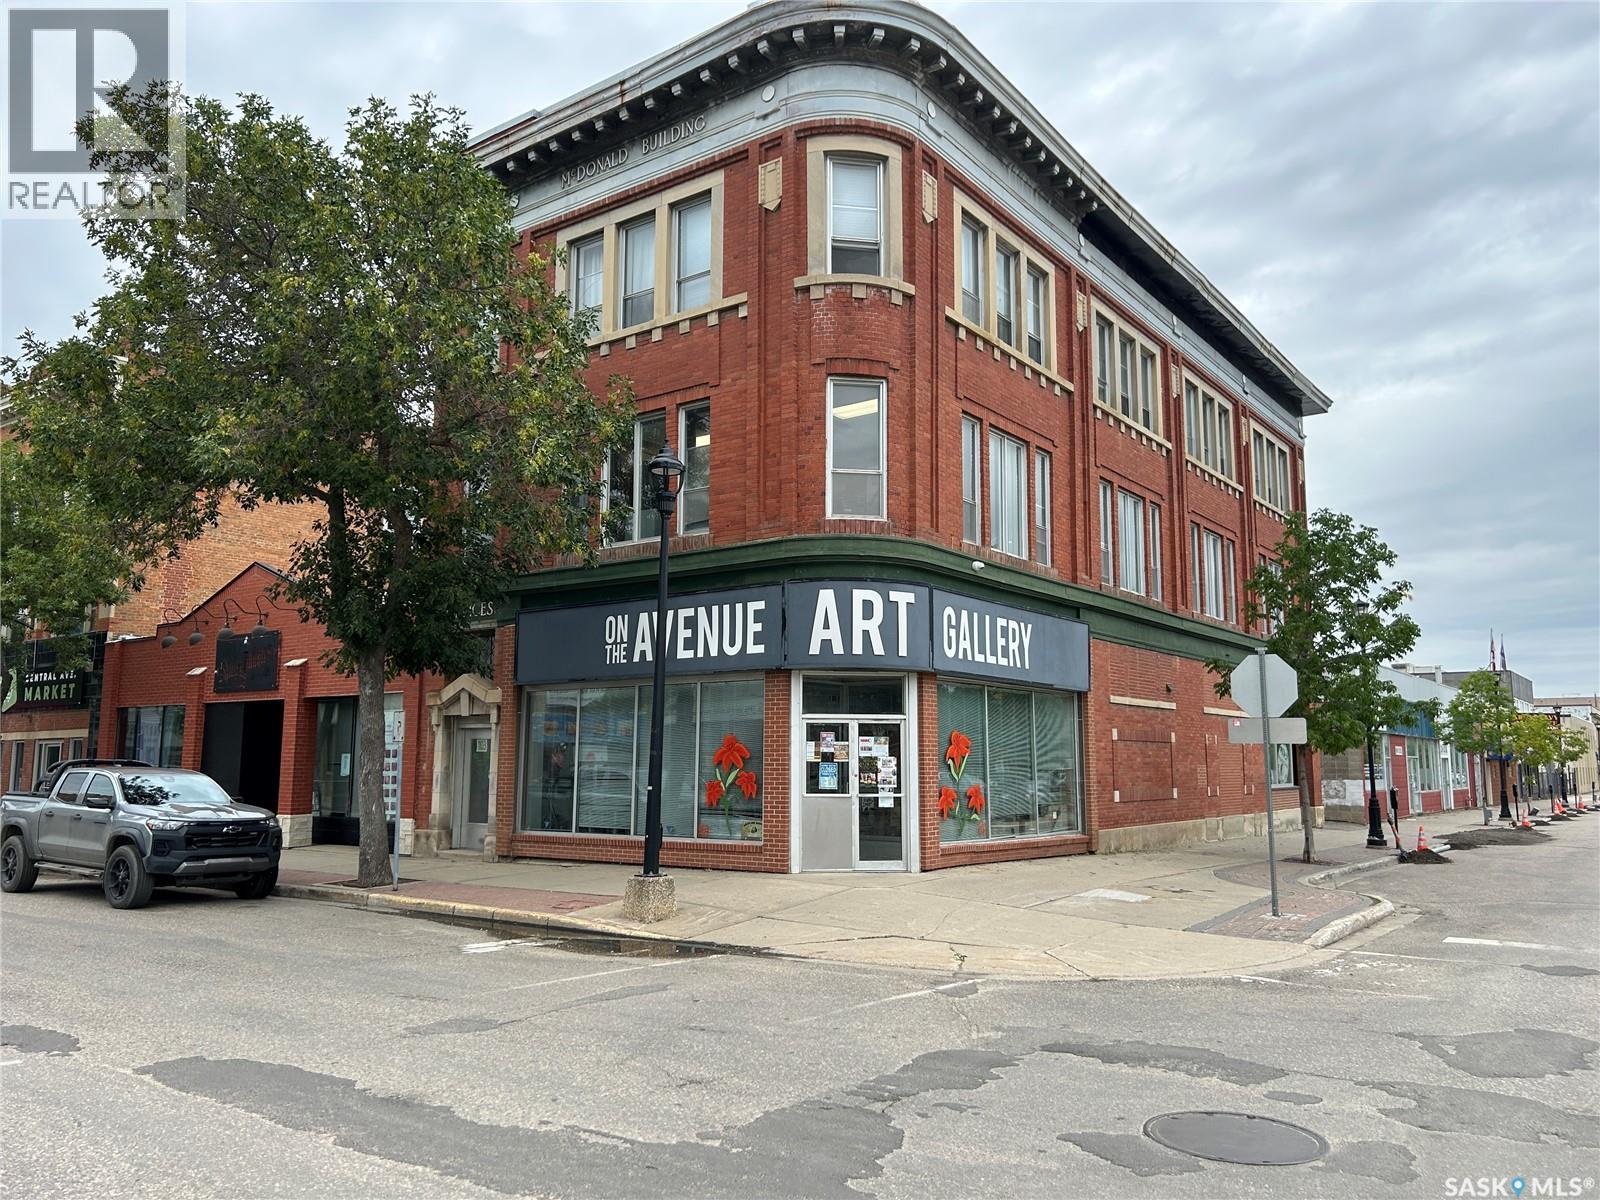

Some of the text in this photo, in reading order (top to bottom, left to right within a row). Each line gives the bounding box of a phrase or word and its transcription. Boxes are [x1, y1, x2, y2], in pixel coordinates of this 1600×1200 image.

[642, 115, 706, 154] BUILDING
[605, 614, 629, 643] ON
[633, 589, 1033, 670] AVENUE ART GALLERY
[605, 644, 627, 664] THE
[25, 672, 57, 682] CENTRAL
[24, 683, 76, 702] MARKET
